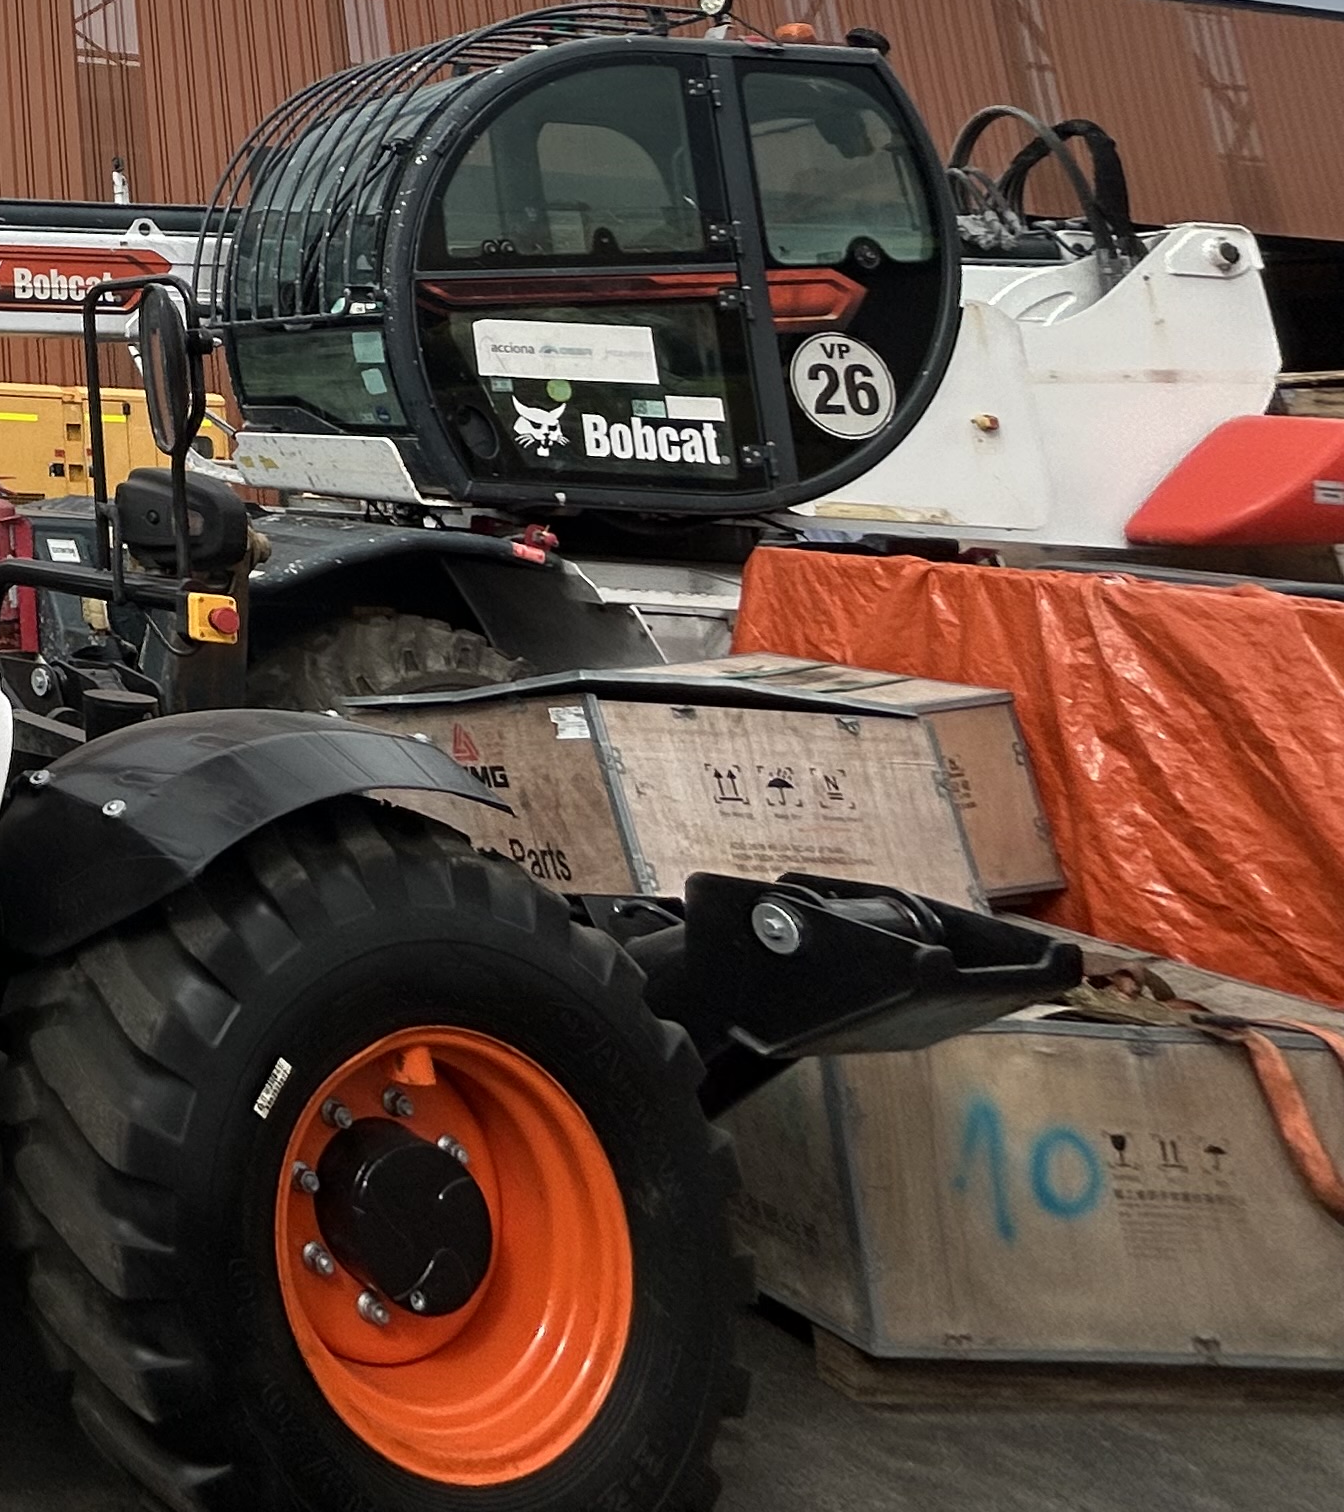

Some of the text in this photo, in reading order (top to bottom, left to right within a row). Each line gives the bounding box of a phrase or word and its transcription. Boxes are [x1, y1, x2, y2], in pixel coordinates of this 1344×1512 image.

[490, 342, 536, 354] acciona
[820, 342, 851, 359] VP
[808, 363, 879, 416] 26
[581, 413, 722, 465] Bobcat
[508, 837, 572, 881] Parts
[952, 1092, 1105, 1245] 10
